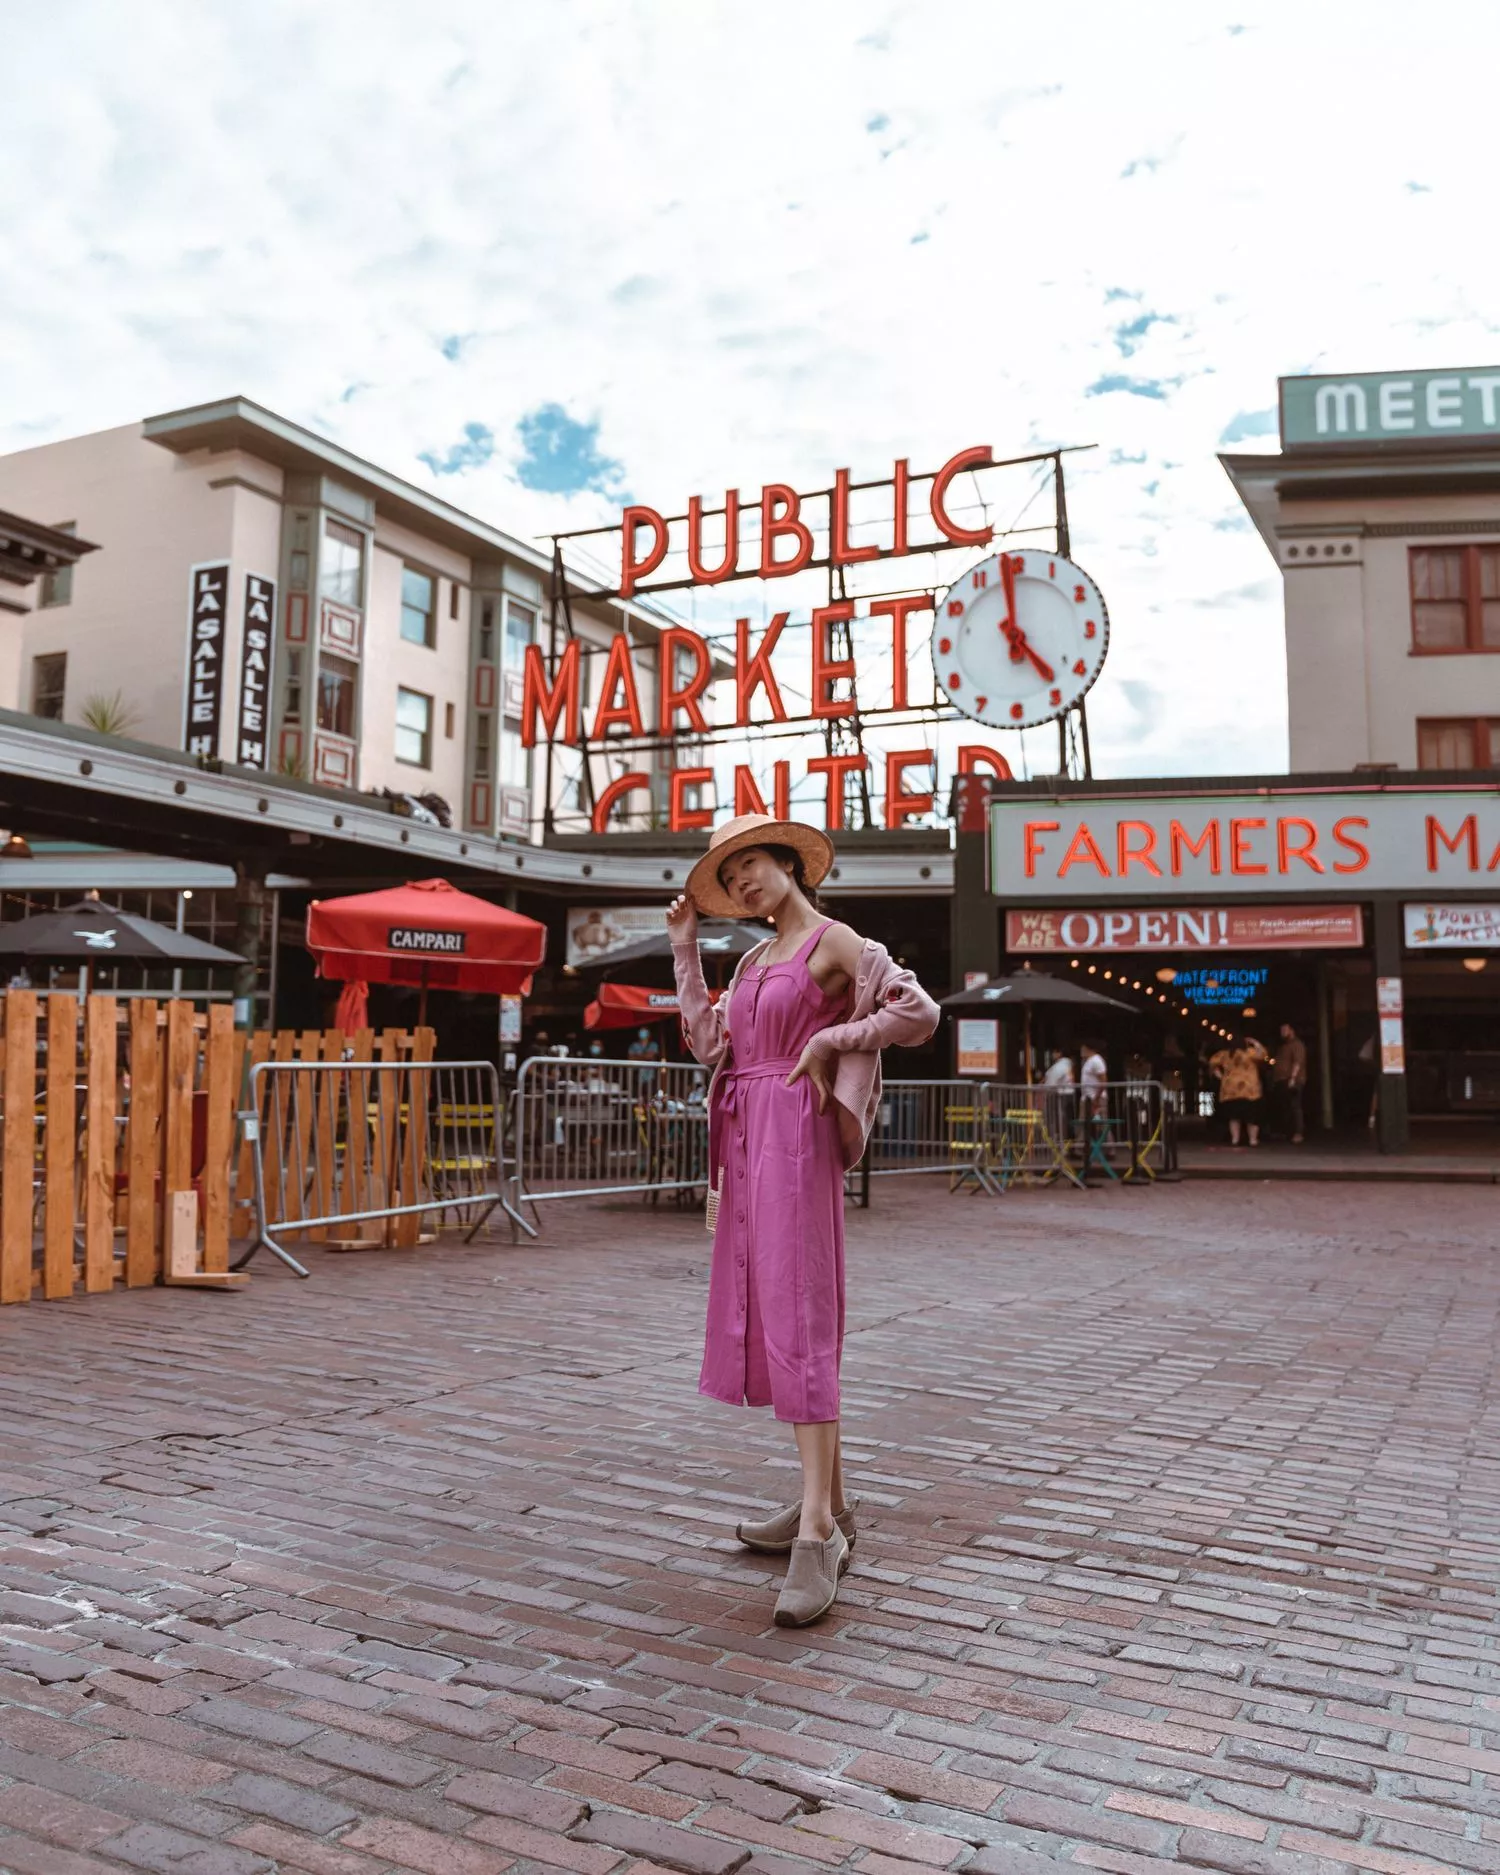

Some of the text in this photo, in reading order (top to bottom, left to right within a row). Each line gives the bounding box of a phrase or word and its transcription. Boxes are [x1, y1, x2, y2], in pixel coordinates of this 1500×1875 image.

[1315, 376, 1500, 433] MEET
[619, 445, 993, 598] PUBLIC
[1049, 561, 1055, 578] 1
[972, 570, 987, 589] 11
[196, 573, 221, 613] LA
[1073, 585, 1086, 603] 2
[947, 600, 964, 617] 10
[1084, 620, 1096, 640] 3
[939, 638, 951, 656] 9
[191, 618, 220, 724] SALLE
[241, 579, 269, 770] LA SALLE H
[521, 594, 934, 749] MARKET
[1072, 659, 1086, 677] 4
[948, 672, 960, 691] 8
[976, 696, 988, 714] 7
[1050, 688, 1062, 707] 5
[1010, 702, 1024, 720] 6
[1023, 812, 1500, 878] FARMERS M
[1021, 914, 1055, 931] WE
[1439, 909, 1493, 926] POWER
[1015, 930, 1057, 948] ARE
[1060, 910, 1228, 949] OPEN!
[391, 929, 462, 951] CAMPARI
[1183, 985, 1256, 999] VIEWPOINT
